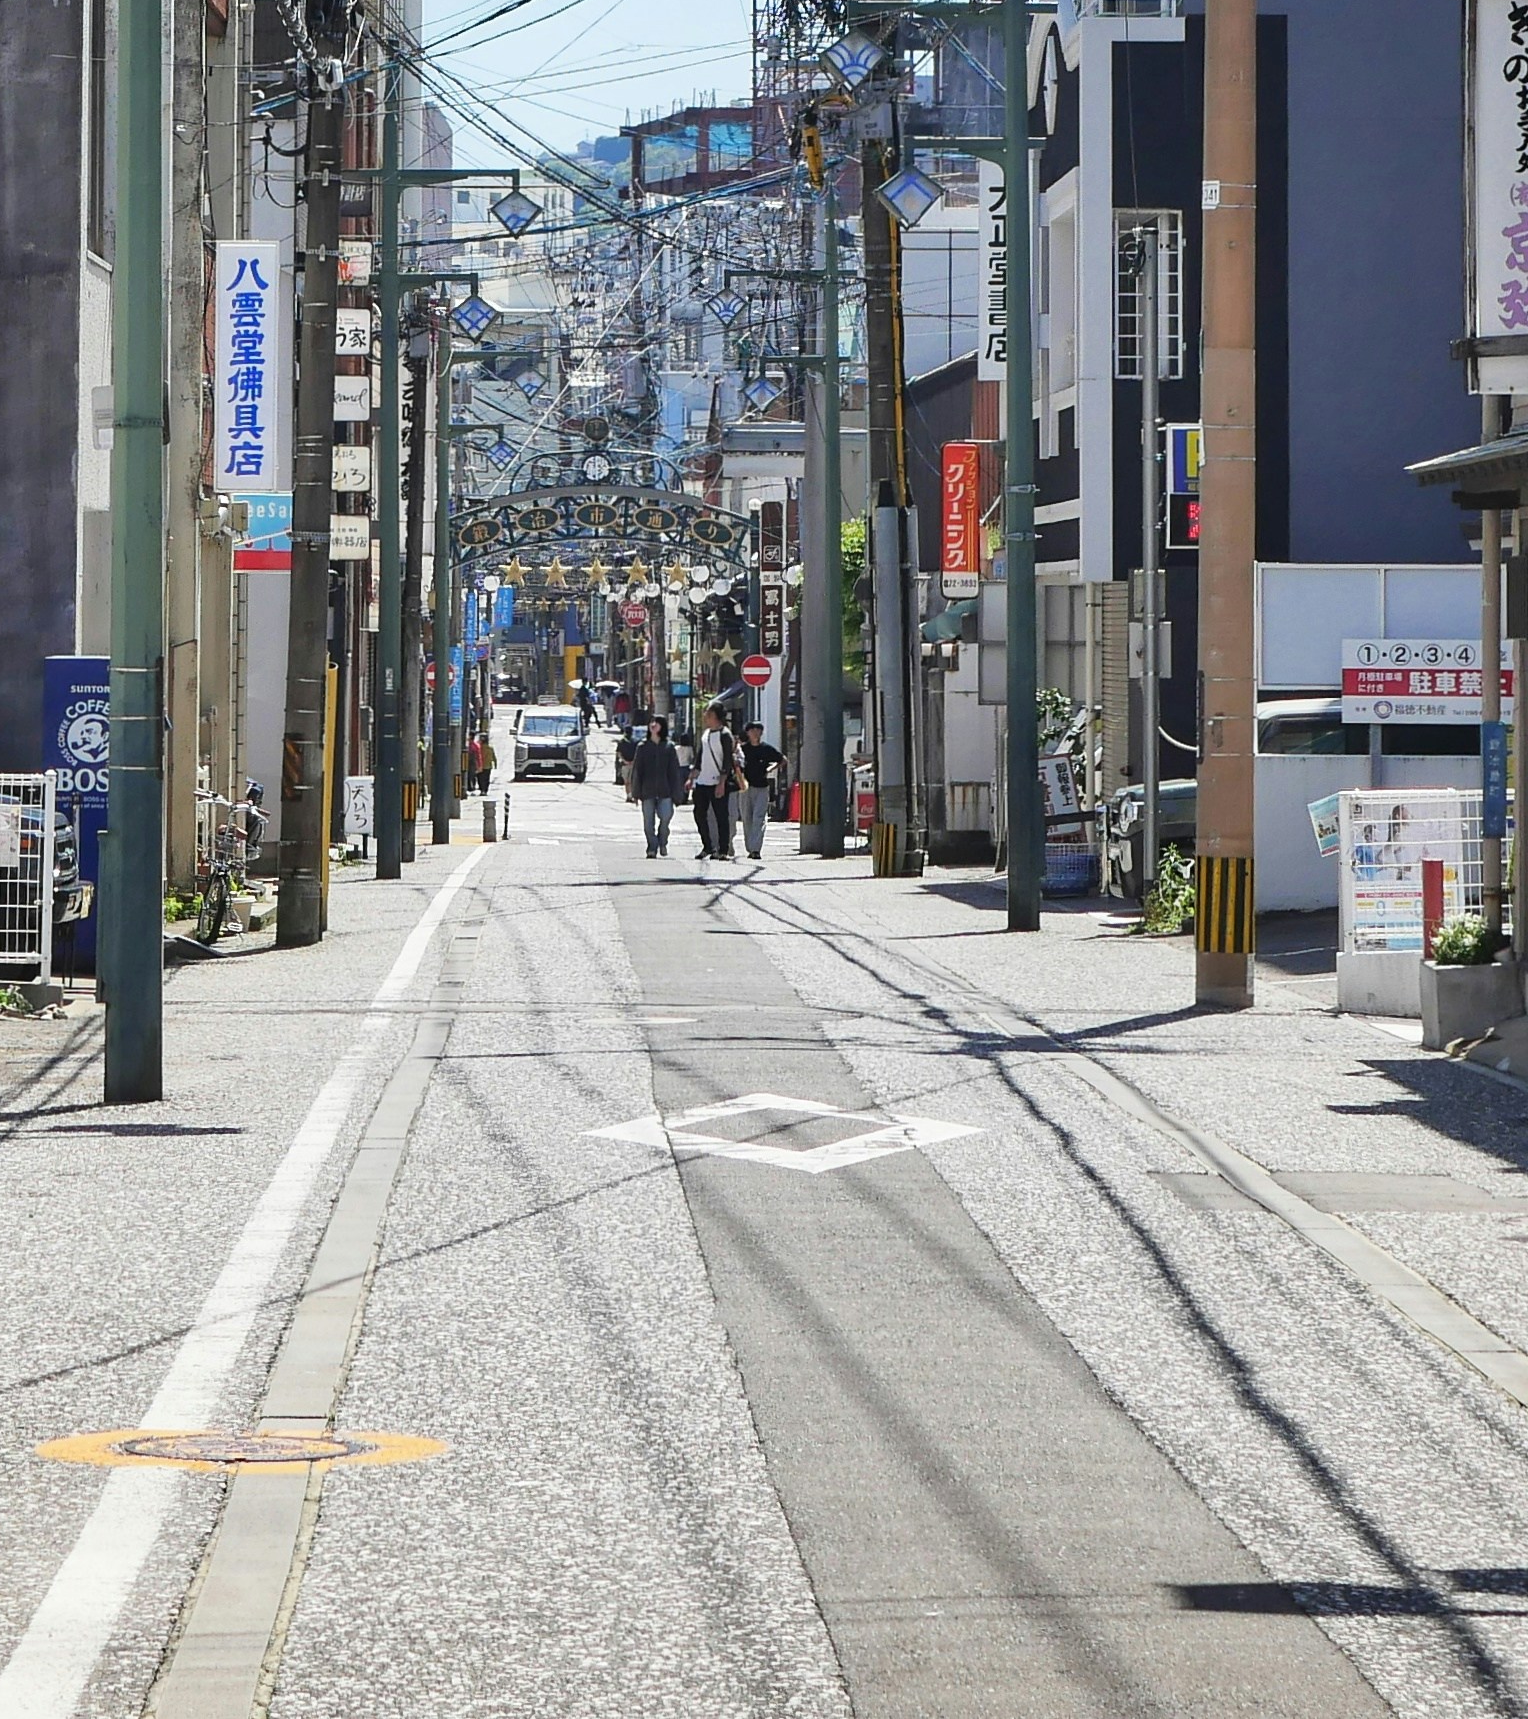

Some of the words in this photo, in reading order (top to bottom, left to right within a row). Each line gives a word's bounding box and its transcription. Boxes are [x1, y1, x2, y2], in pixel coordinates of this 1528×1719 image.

[224, 258, 270, 476] 八雲堂佛具店
[945, 464, 966, 569] クリーニング
[764, 589, 779, 647] 富士男
